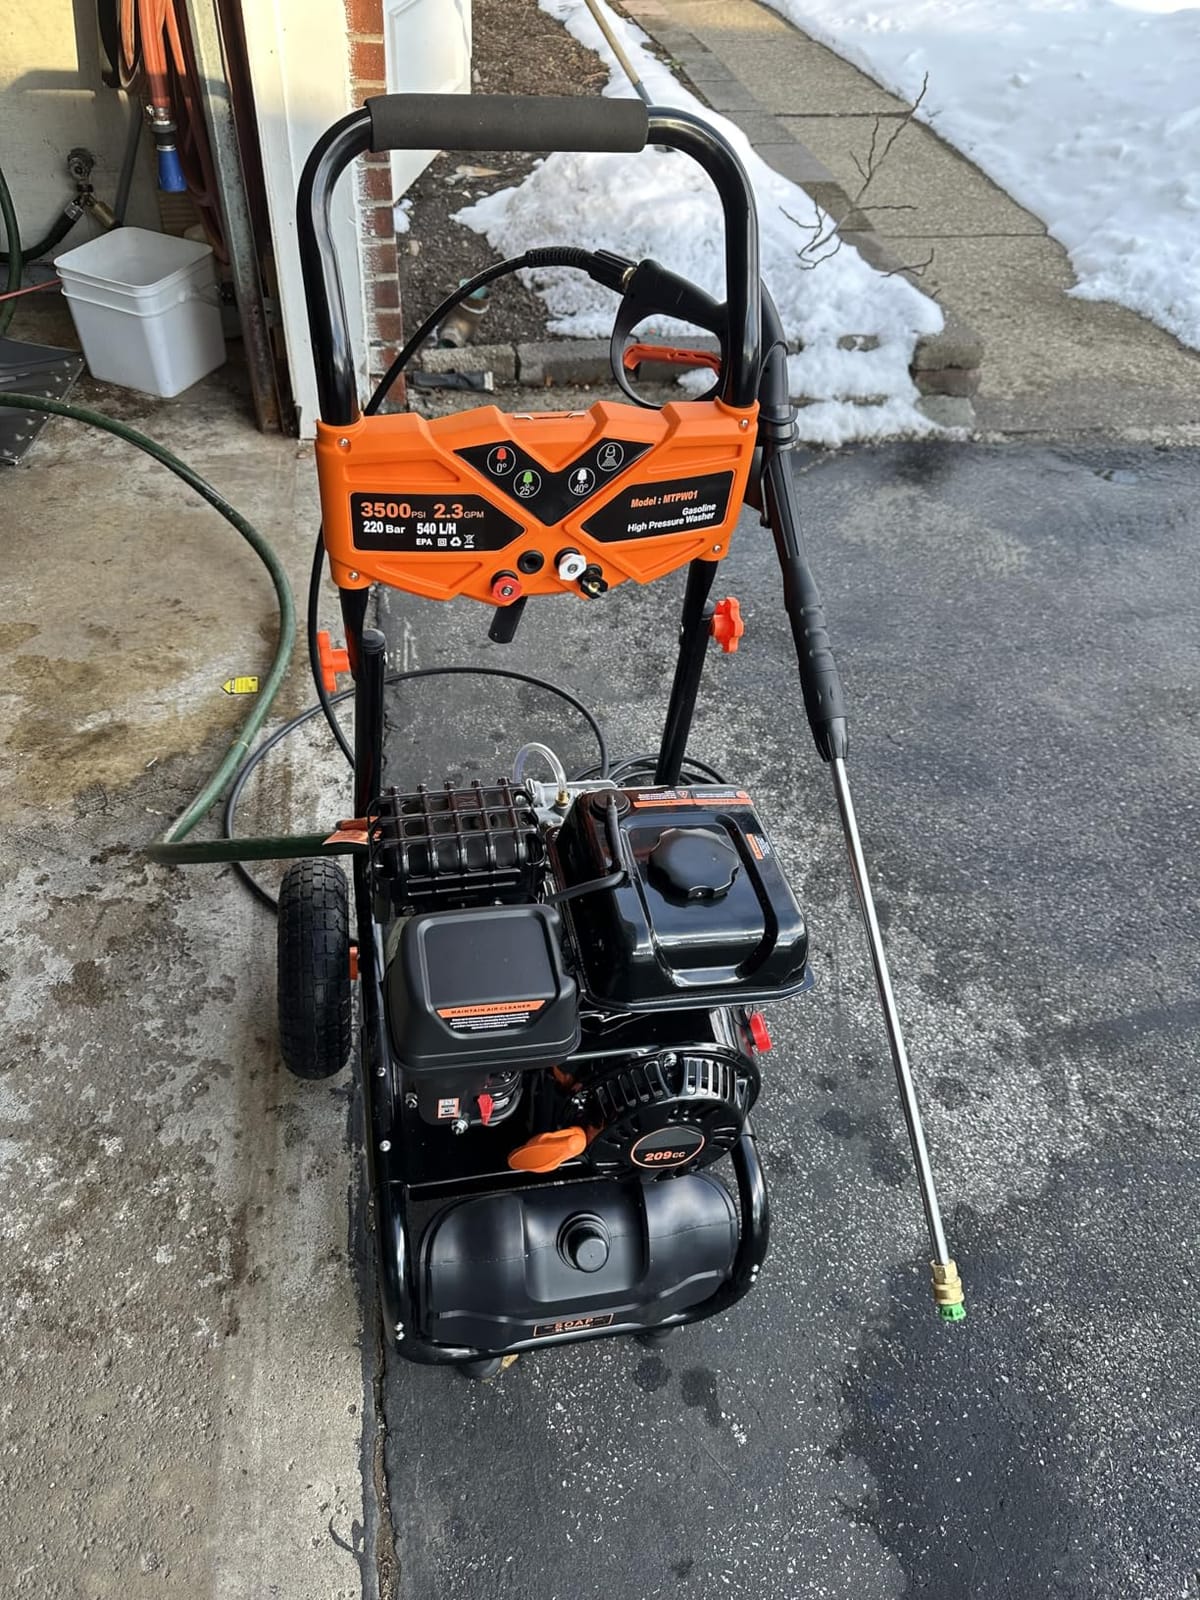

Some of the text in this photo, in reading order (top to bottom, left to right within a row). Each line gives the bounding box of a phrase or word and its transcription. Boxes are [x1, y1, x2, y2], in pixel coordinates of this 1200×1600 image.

[630, 496, 657, 508] Model
[662, 490, 699, 504] MTPW01
[682, 503, 717, 516] Gasoline
[363, 521, 457, 535] 220 Bar 540 L/H
[627, 511, 715, 533] High Pressure Washer
[415, 537, 433, 546] EPA
[554, 1317, 594, 1330] SOAP
